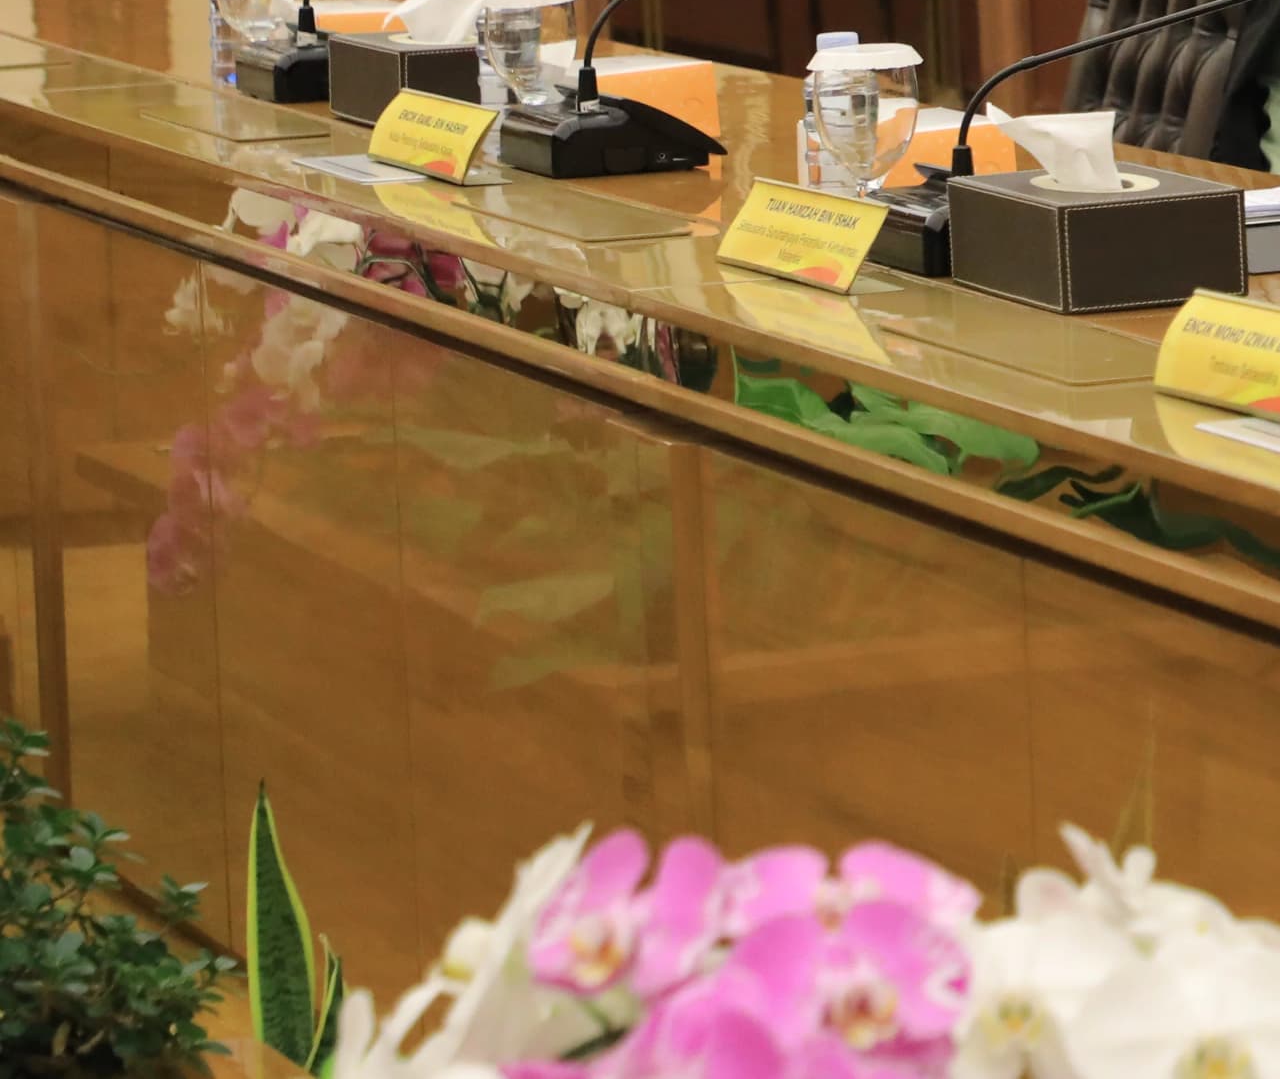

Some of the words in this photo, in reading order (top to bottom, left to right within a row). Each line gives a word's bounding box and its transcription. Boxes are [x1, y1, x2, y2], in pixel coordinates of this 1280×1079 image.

[766, 198, 787, 212] TUAN
[786, 202, 818, 220] HAMZAH
[817, 209, 834, 224] BIN
[832, 212, 861, 229] ISHAK
[1182, 317, 1216, 336] ENCIK
[1213, 324, 1245, 343] MOHD
[1243, 331, 1276, 350] IZWAN
